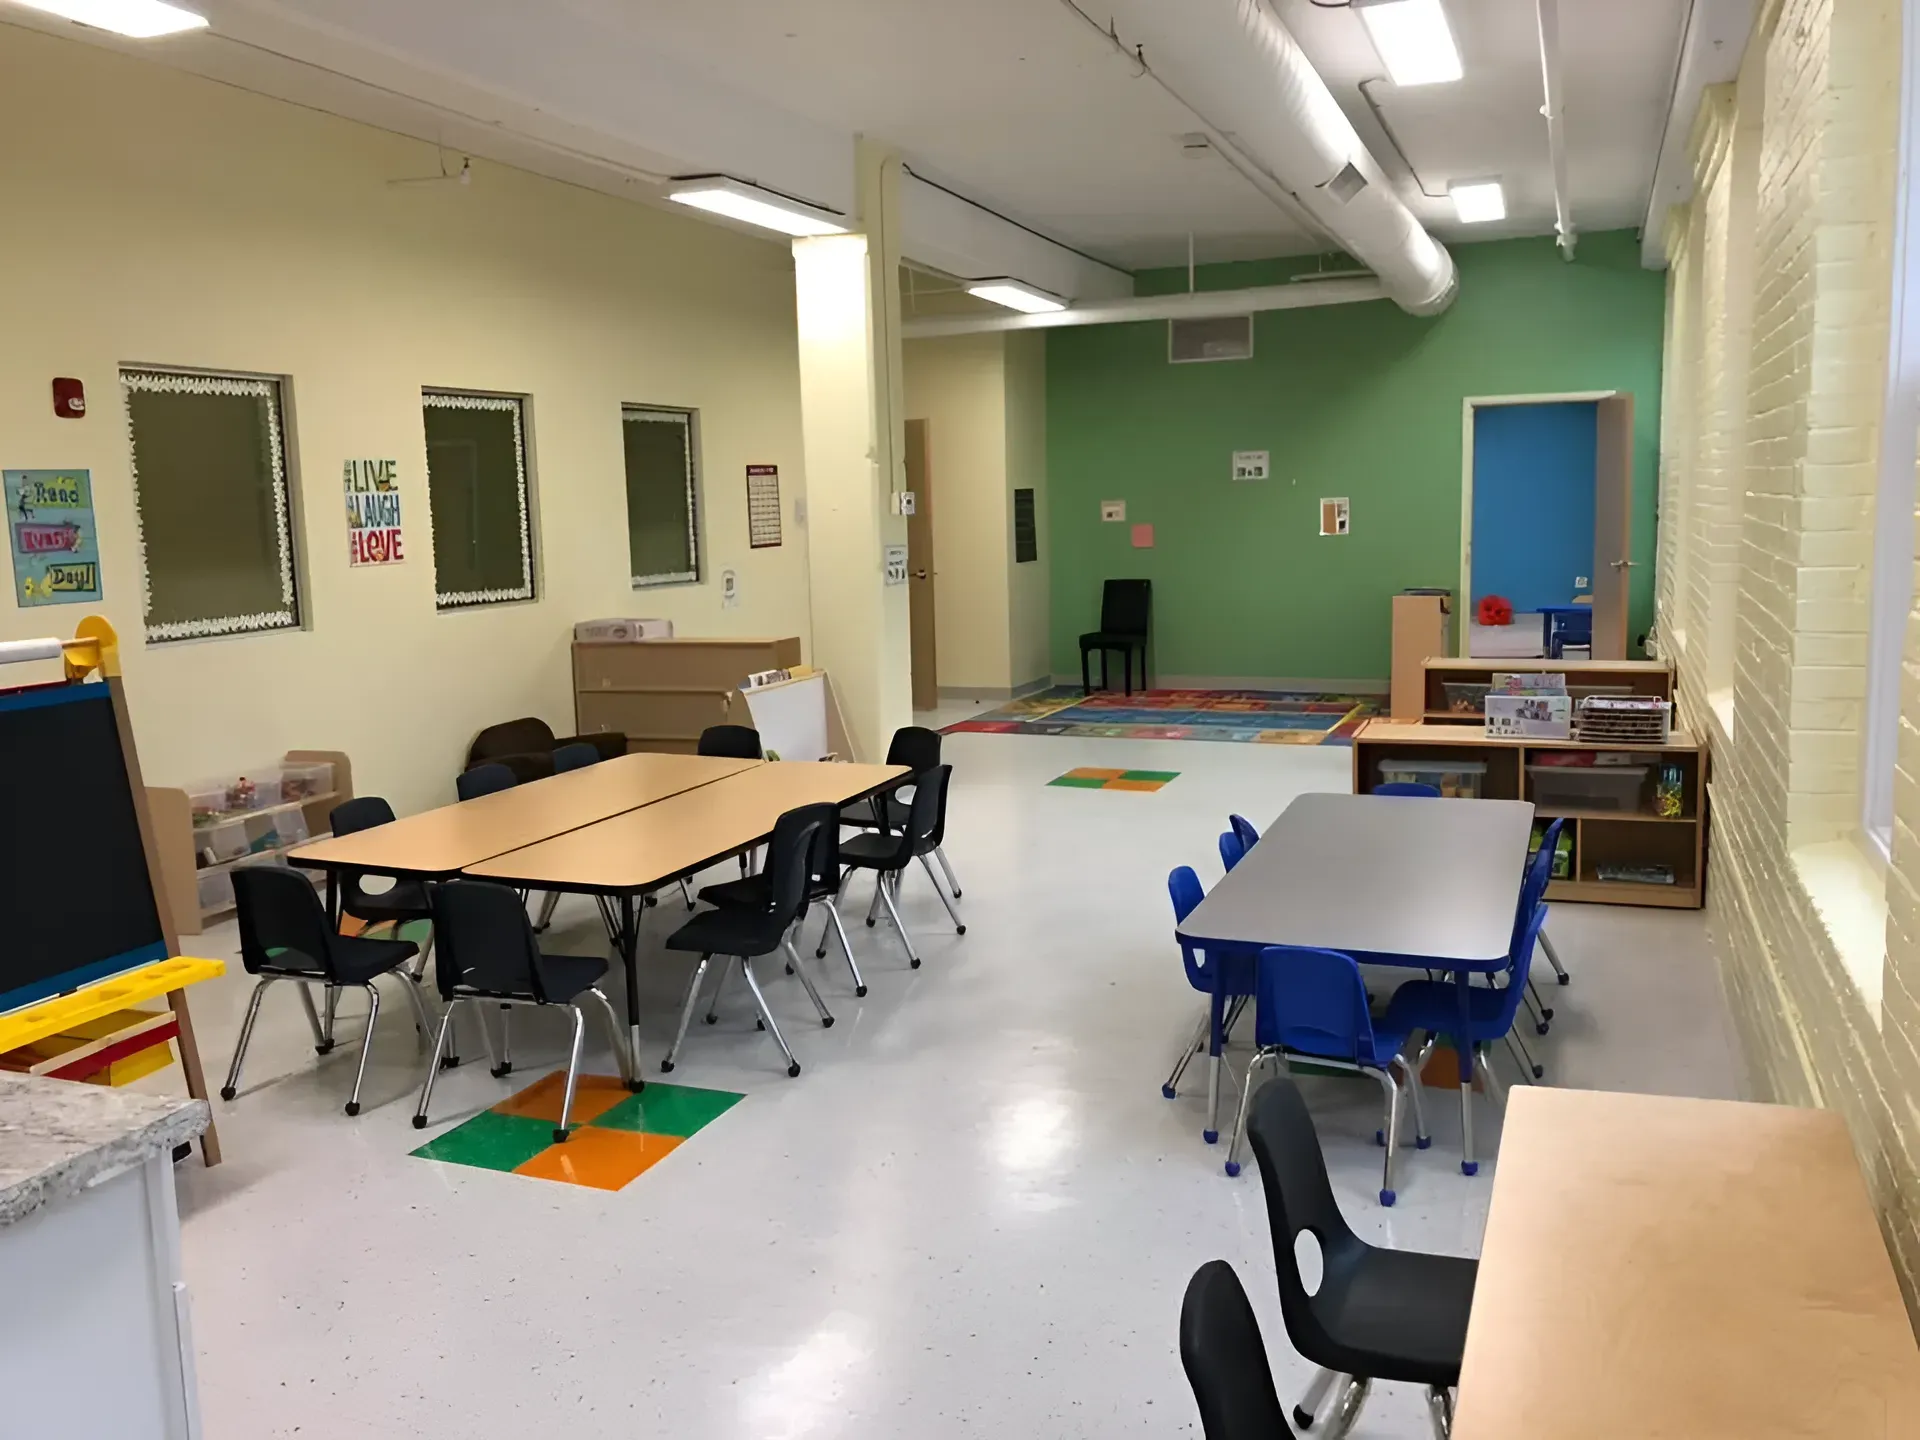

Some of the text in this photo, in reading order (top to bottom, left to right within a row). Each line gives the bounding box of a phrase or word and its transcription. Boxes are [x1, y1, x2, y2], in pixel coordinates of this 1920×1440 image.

[353, 460, 398, 492] LIVE
[355, 494, 401, 528] LAUGH
[358, 529, 404, 563] LOVE
